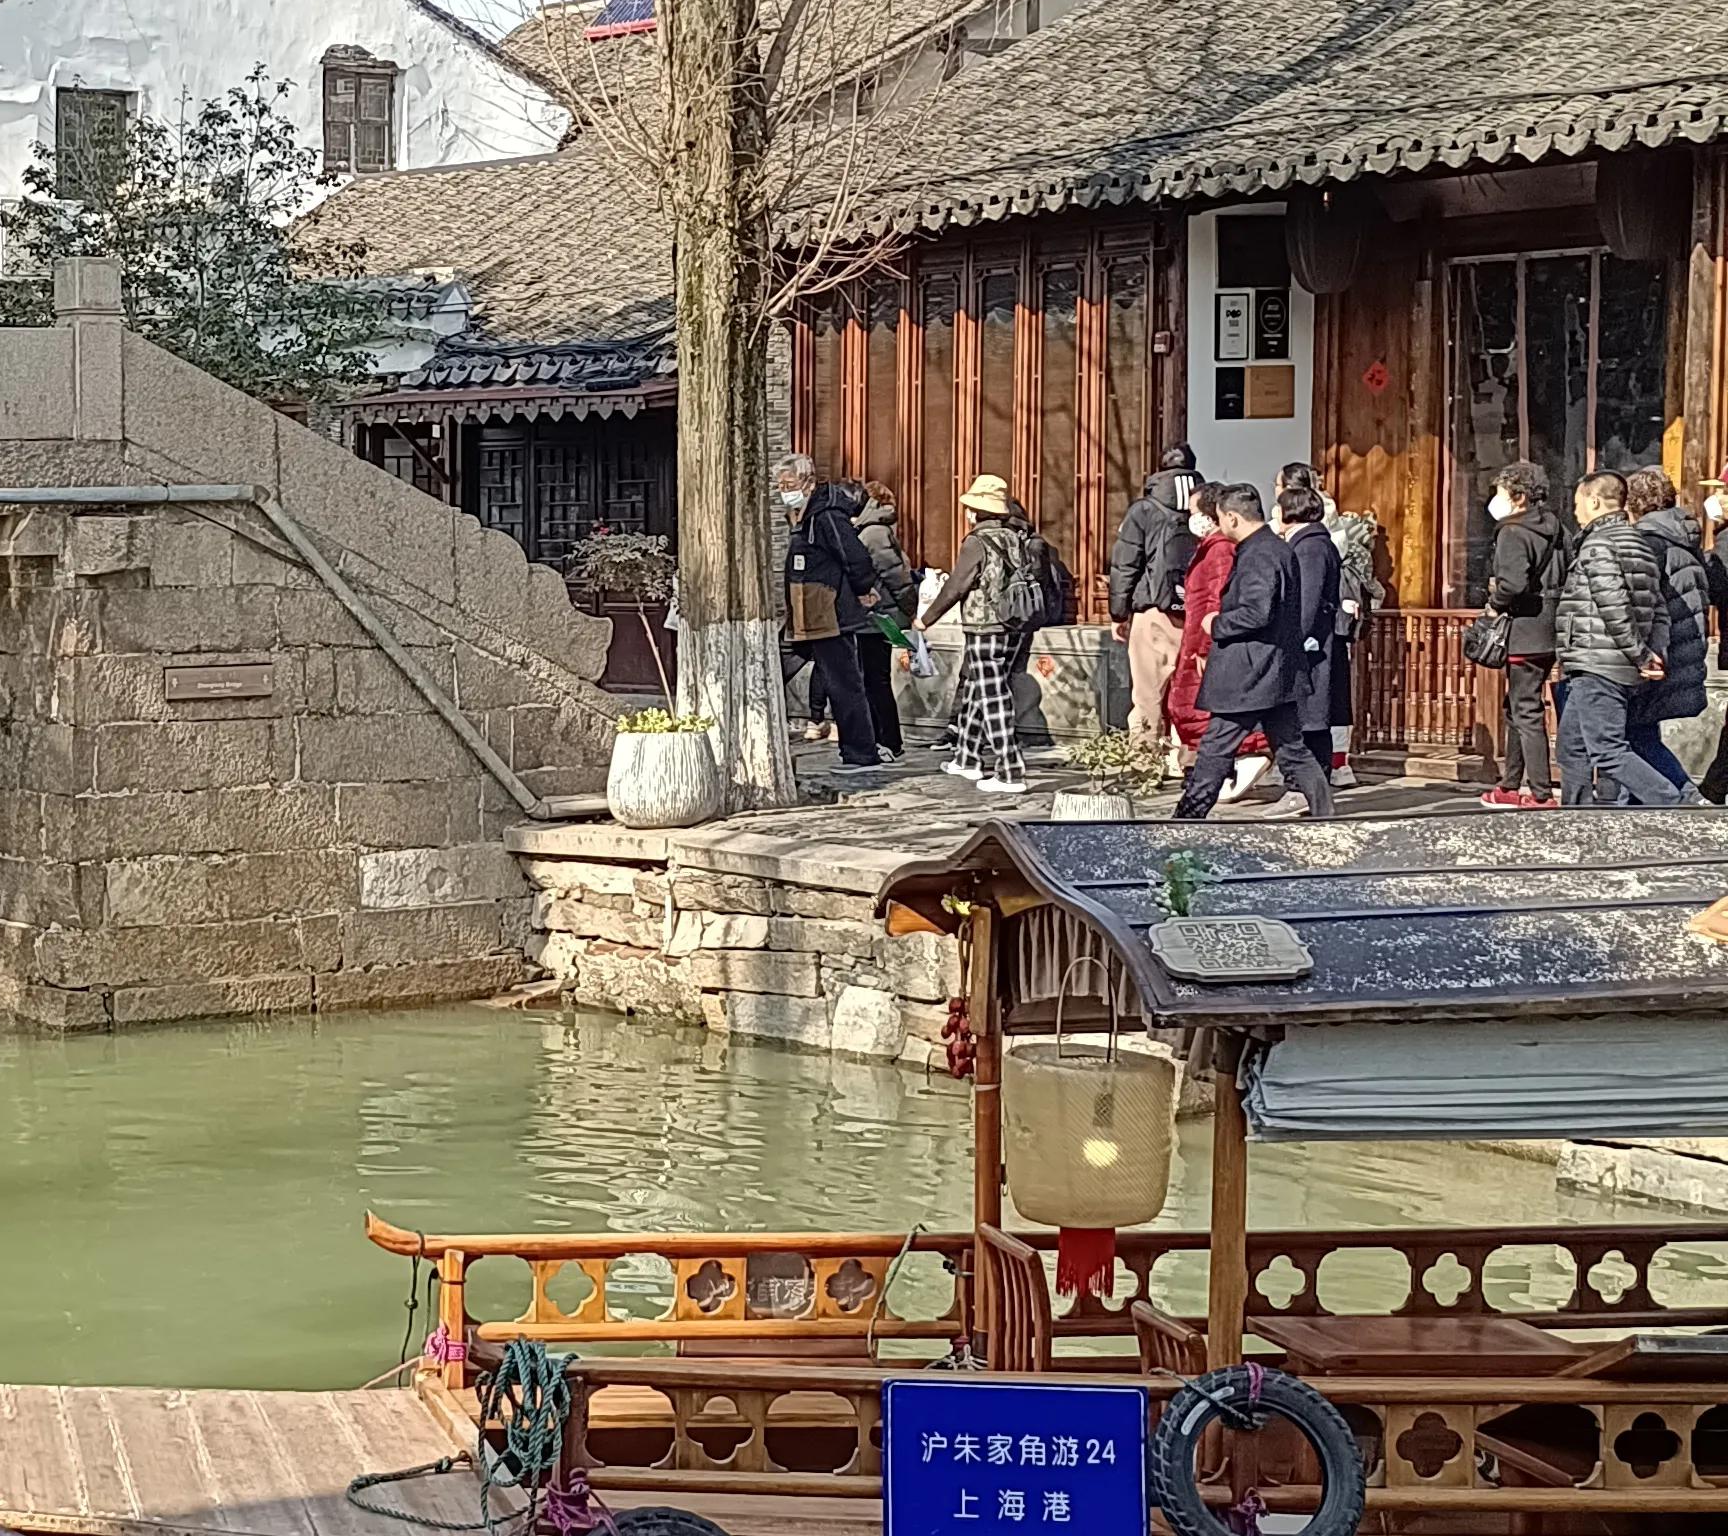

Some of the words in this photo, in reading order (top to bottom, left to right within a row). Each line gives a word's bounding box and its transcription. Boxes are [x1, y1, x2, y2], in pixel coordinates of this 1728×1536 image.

[921, 1431, 1116, 1467] 沪朱家角游24
[953, 1488, 1071, 1522] 上海港
